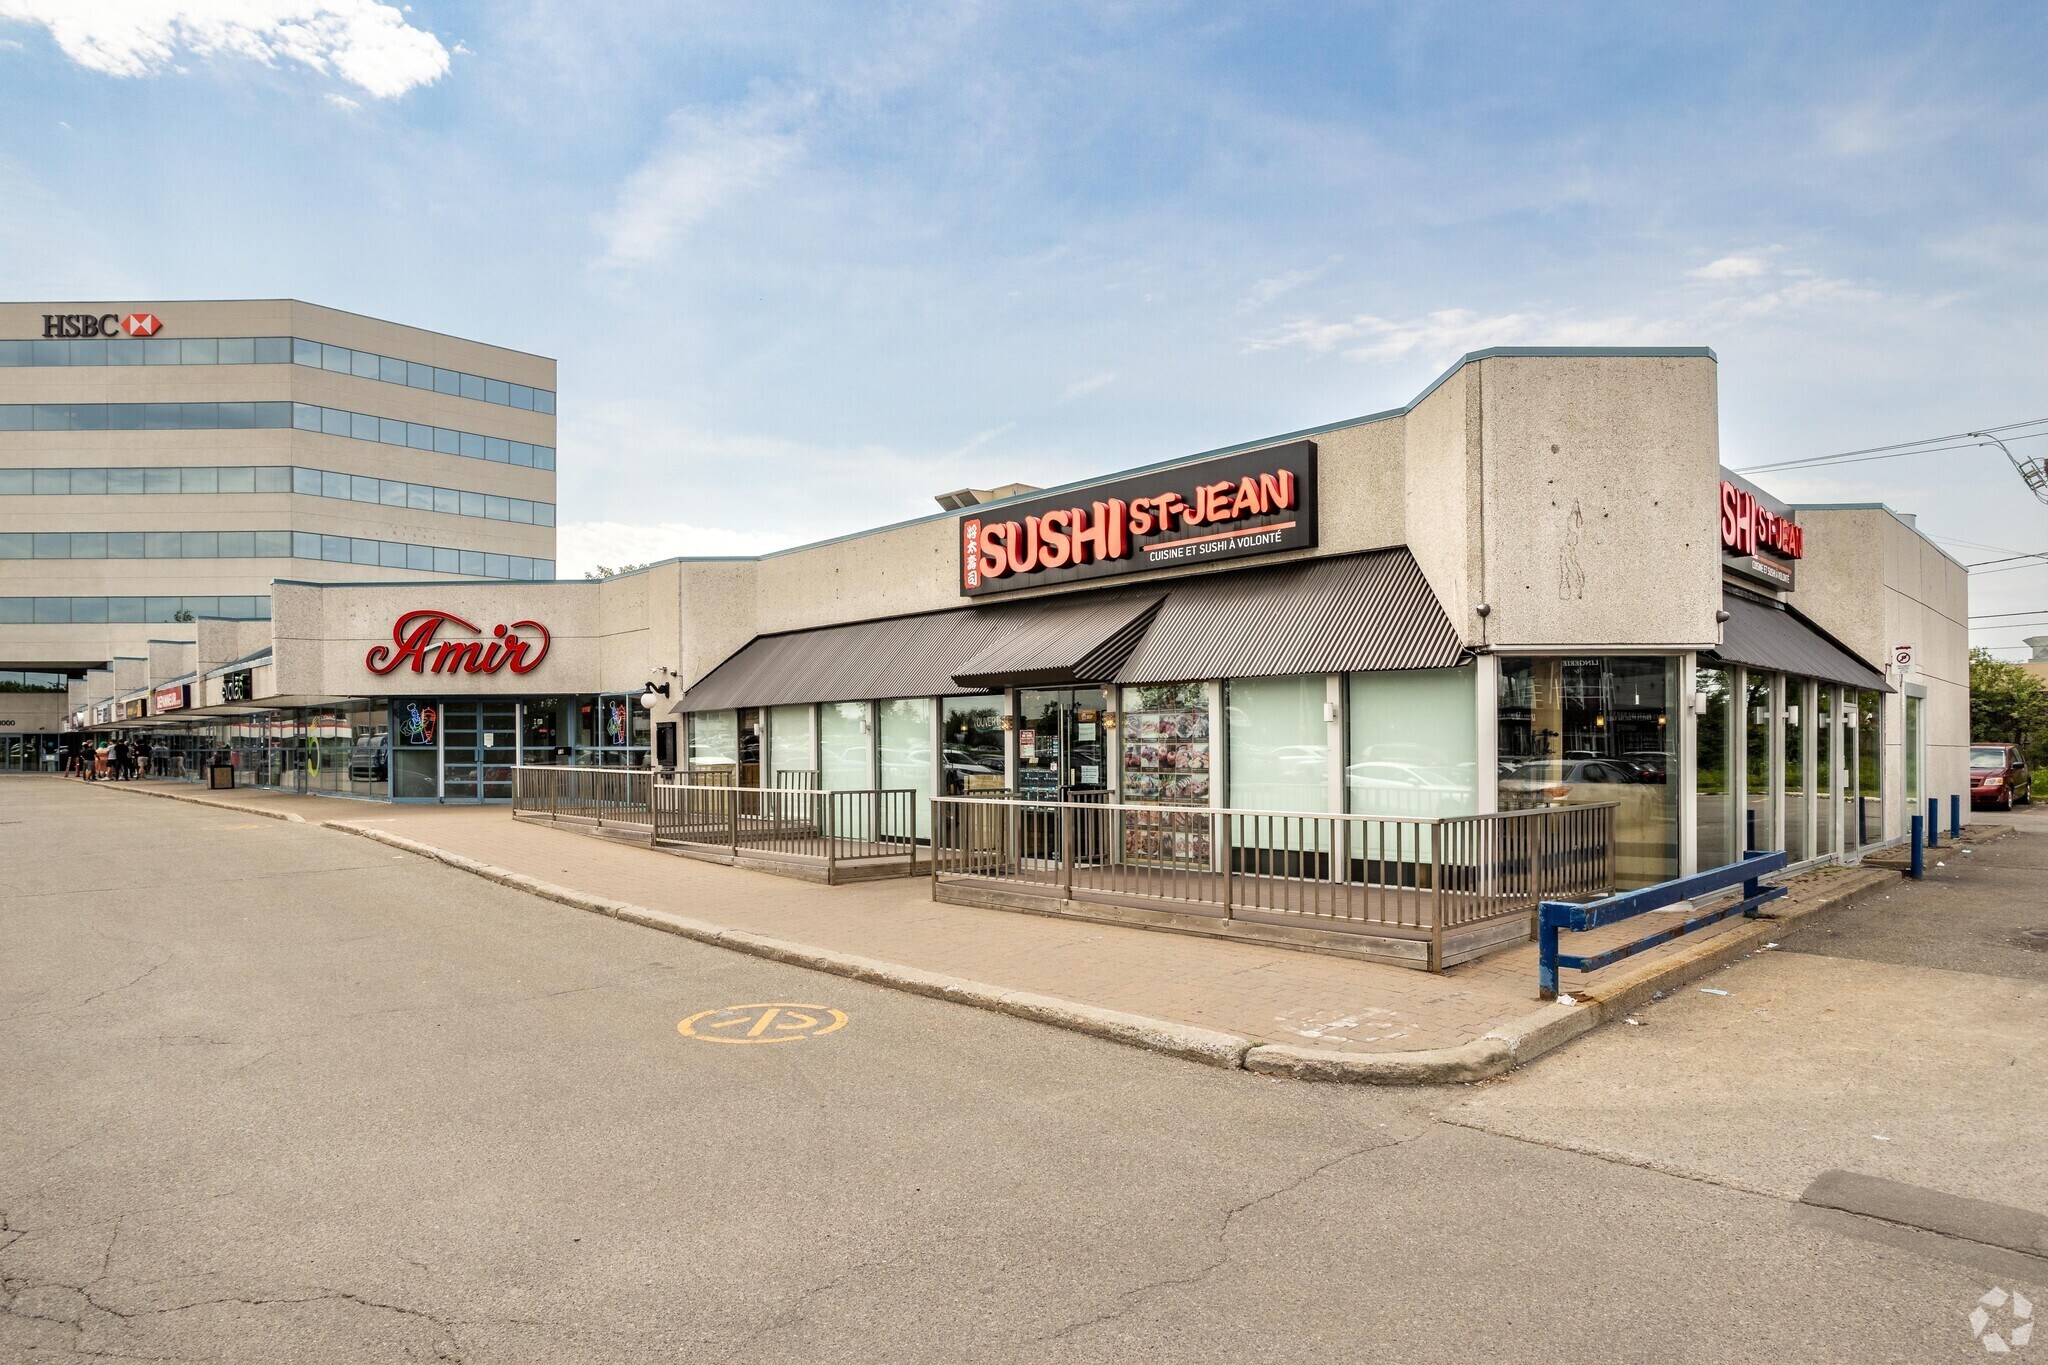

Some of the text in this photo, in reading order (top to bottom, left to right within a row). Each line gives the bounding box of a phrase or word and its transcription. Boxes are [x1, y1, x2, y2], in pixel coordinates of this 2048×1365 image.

[42, 314, 119, 337] HSBC
[979, 468, 1296, 578] SUSHI ST-JEAN
[1149, 529, 1282, 562] CUISINE ET SUSHI À VOLONTÉ
[1720, 480, 1803, 560] SHI ST-JEAN
[366, 610, 550, 675] Amir
